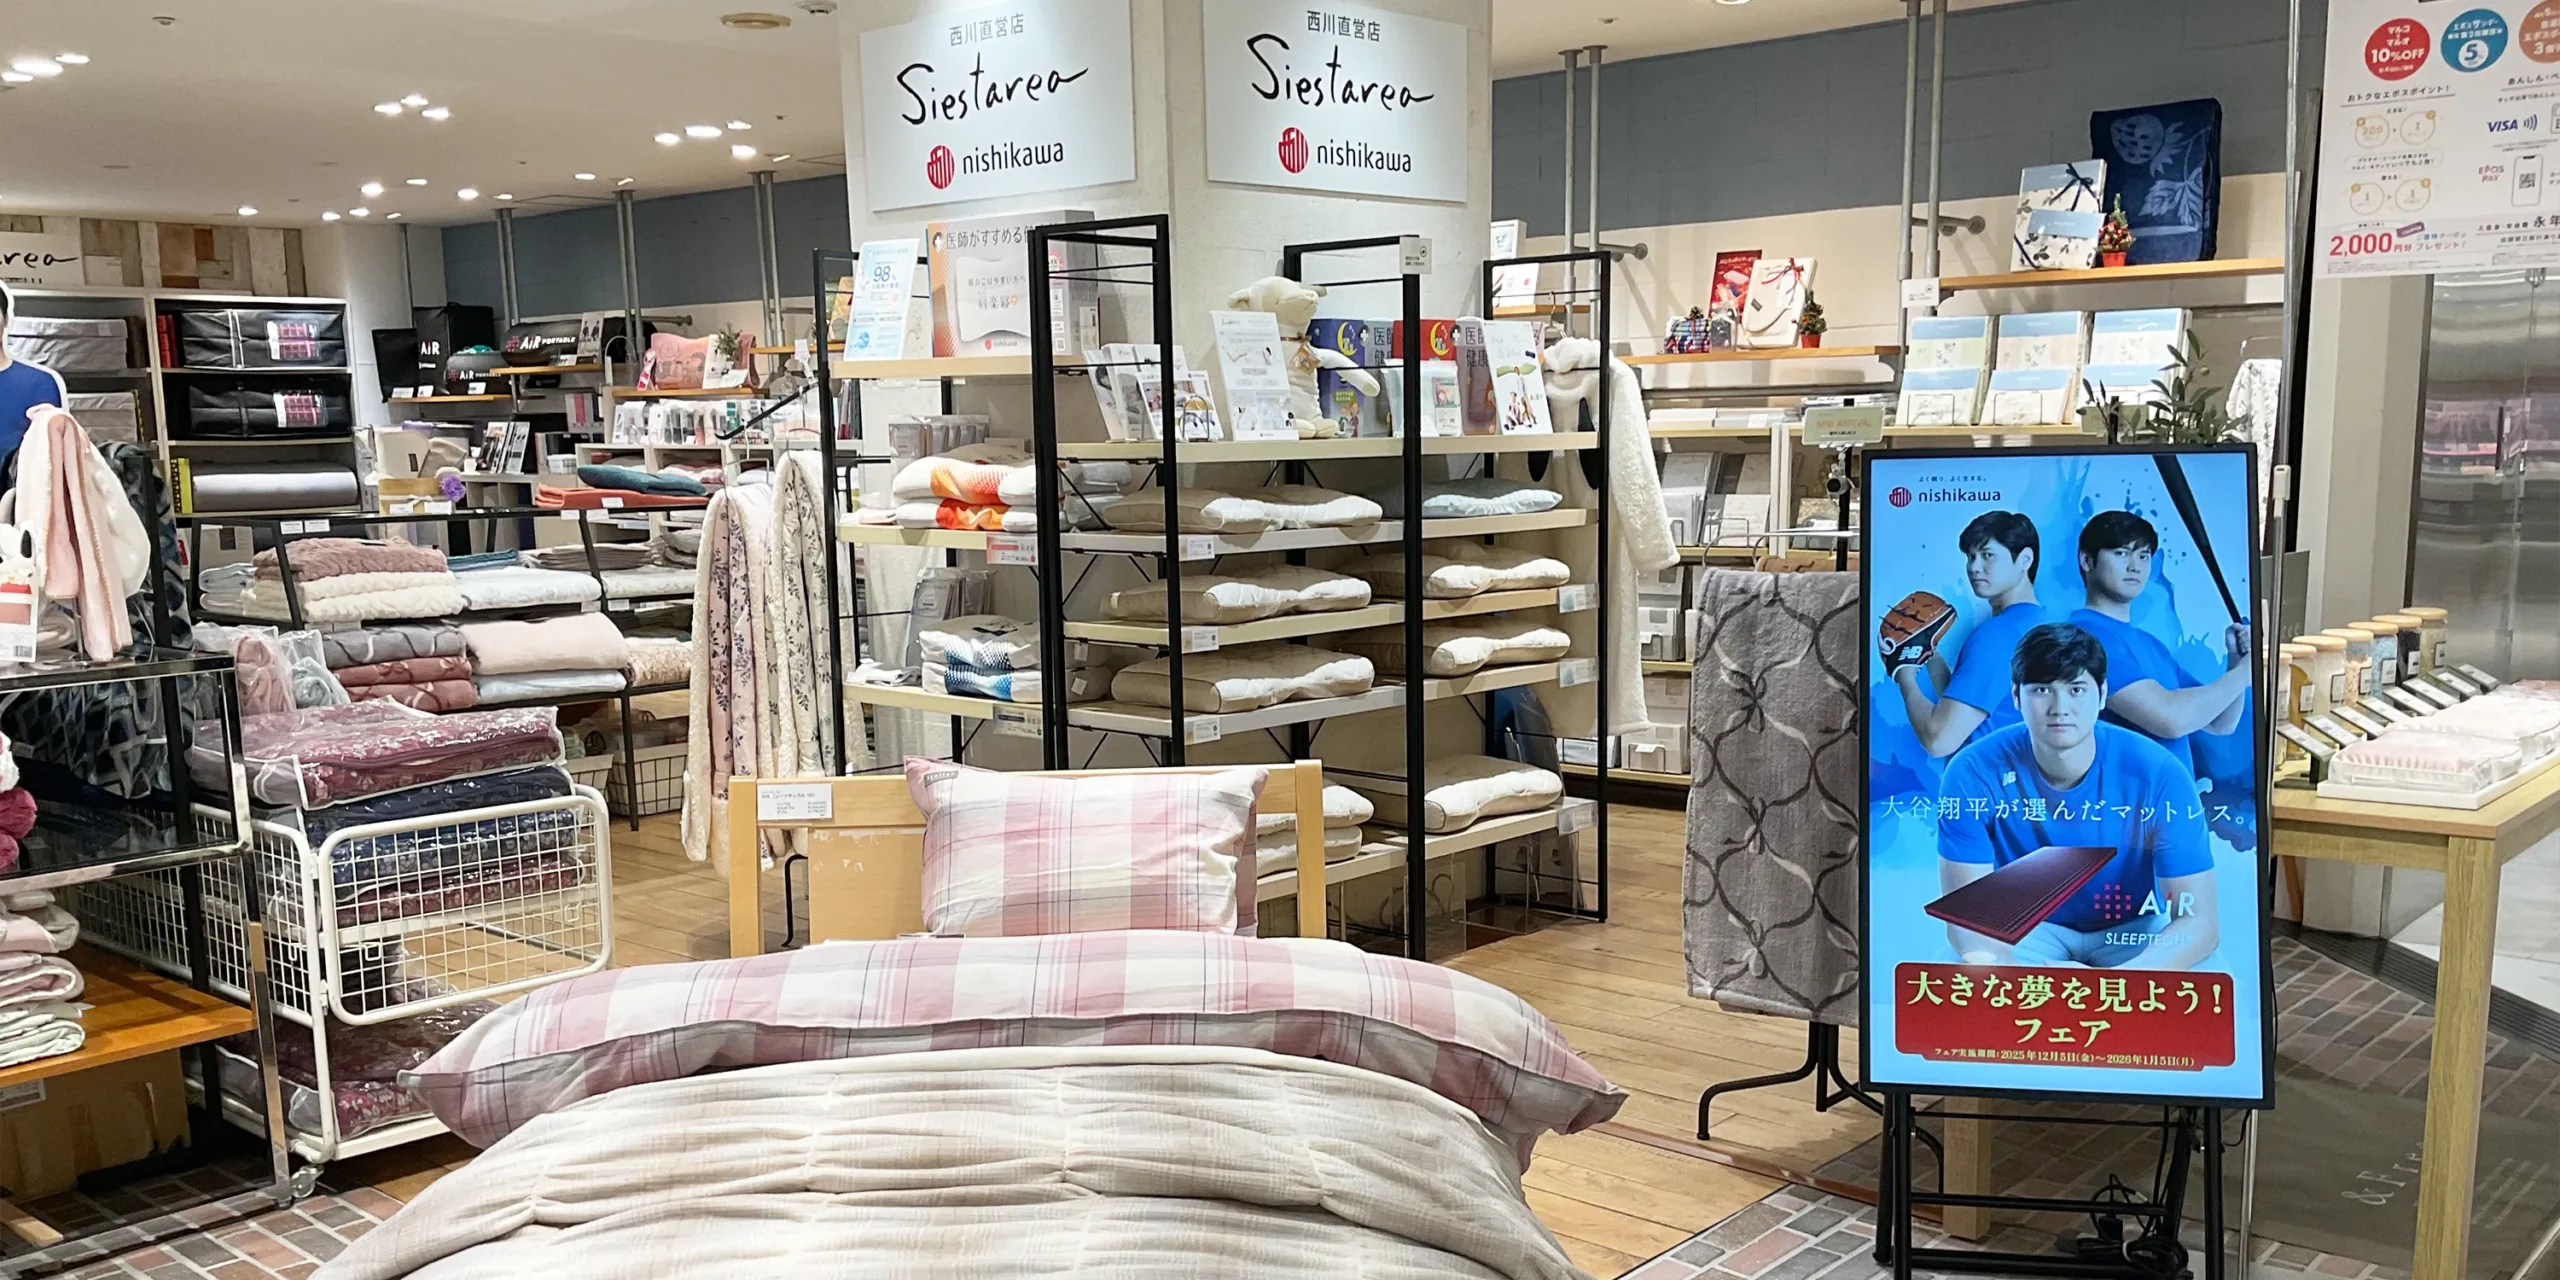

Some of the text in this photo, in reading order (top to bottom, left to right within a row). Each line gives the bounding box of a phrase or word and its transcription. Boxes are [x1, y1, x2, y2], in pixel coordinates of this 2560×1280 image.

[949, 14, 1024, 47] 西川直営店
[1307, 10, 1380, 42] 西川直営店
[2371, 48, 2424, 63] 10%OFF
[1246, 34, 1435, 111] Siestarea
[897, 52, 1089, 125] Siestarea
[2487, 119, 2518, 132] VISA
[963, 141, 1064, 175] nishikawa
[1317, 138, 1411, 173] nishikawa
[2478, 165, 2504, 175] EPOS
[2482, 175, 2498, 183] PAY
[0, 252, 78, 269] rea
[1919, 488, 2001, 502] nishikawa
[1880, 795, 2246, 826] 大谷翔平が選んだマットレス。
[1907, 971, 2223, 1015] 大きな夢を見よう!
[2015, 1018, 2112, 1048] フェア
